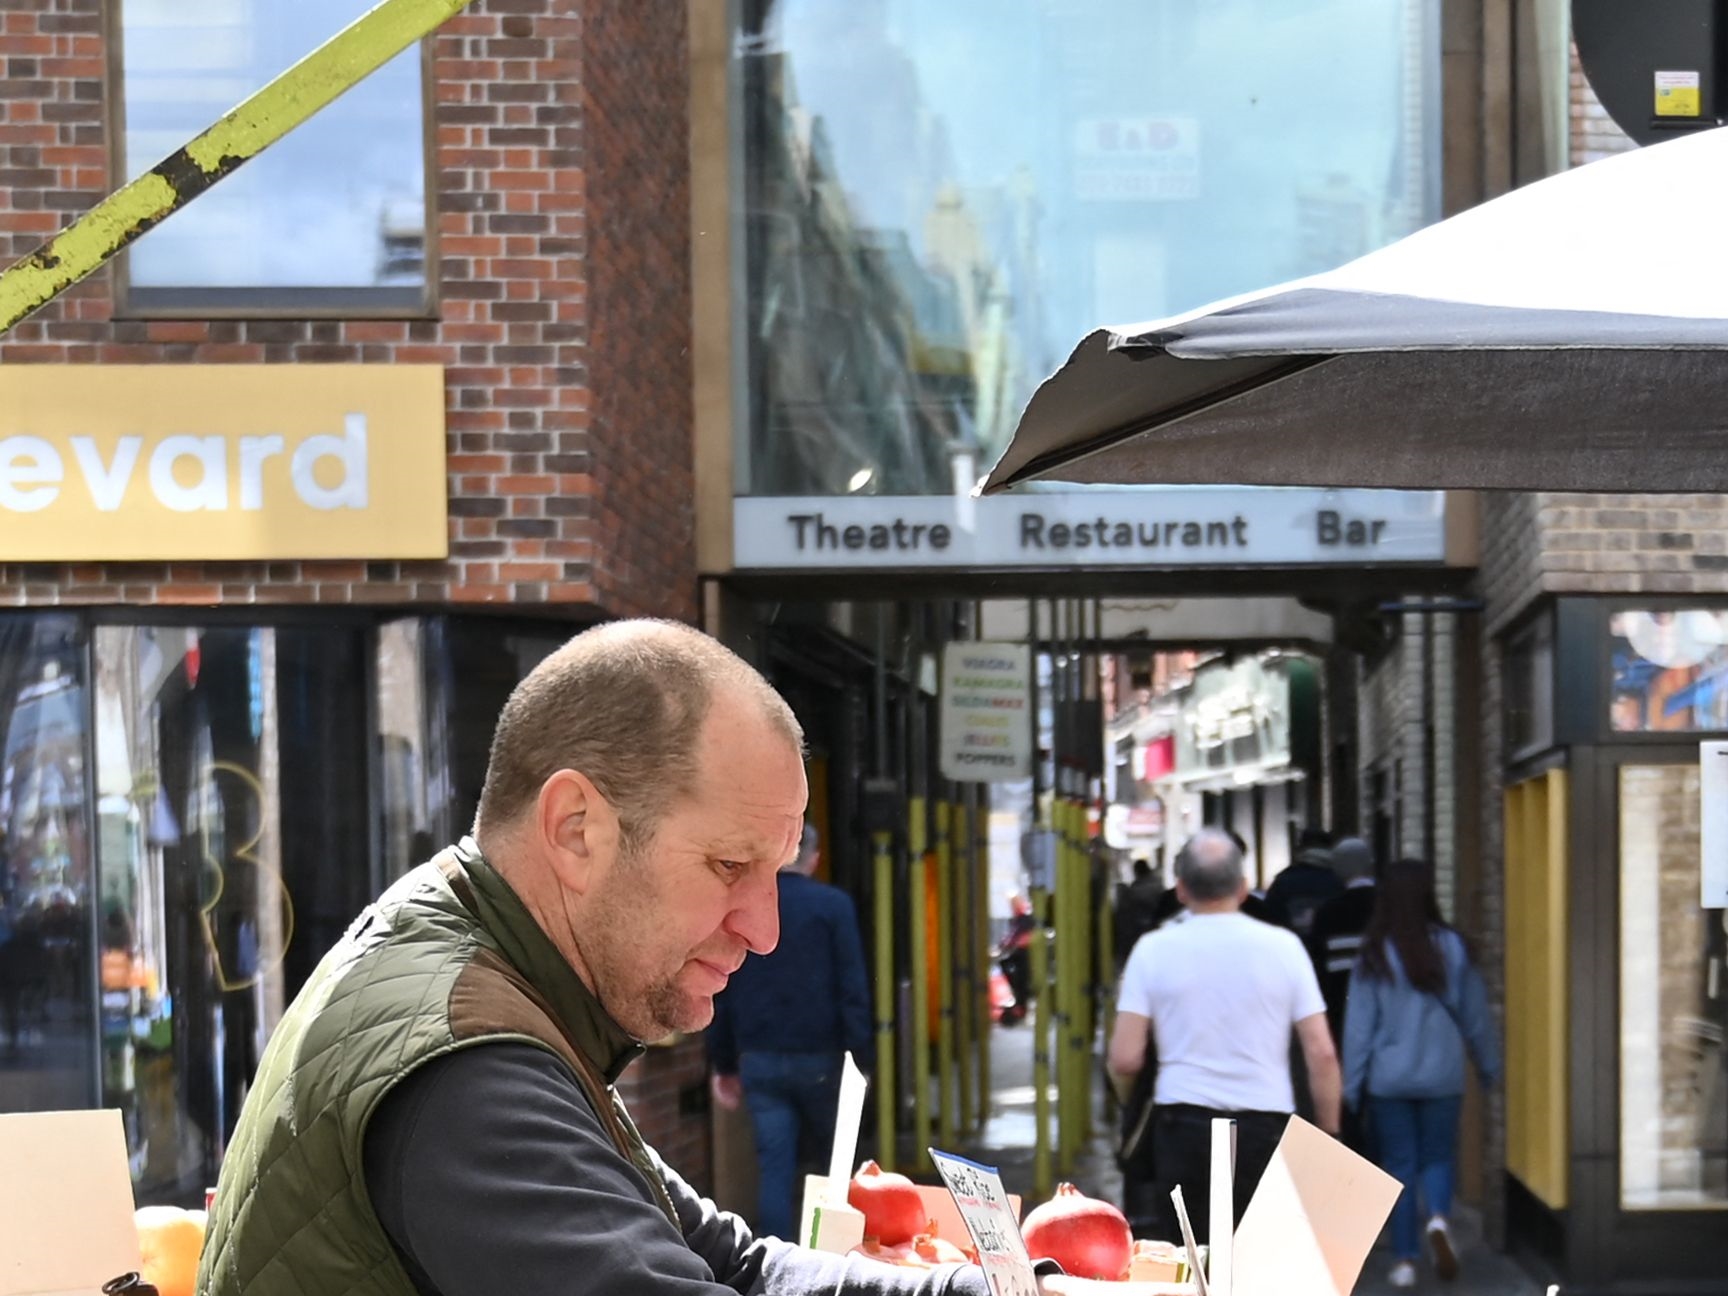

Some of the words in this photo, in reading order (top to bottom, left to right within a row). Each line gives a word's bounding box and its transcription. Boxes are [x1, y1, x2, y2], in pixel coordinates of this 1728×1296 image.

[0, 413, 368, 512] evard
[789, 514, 951, 551] Theatre
[1019, 513, 1248, 549] Restaurant
[1316, 510, 1388, 546] Bar
